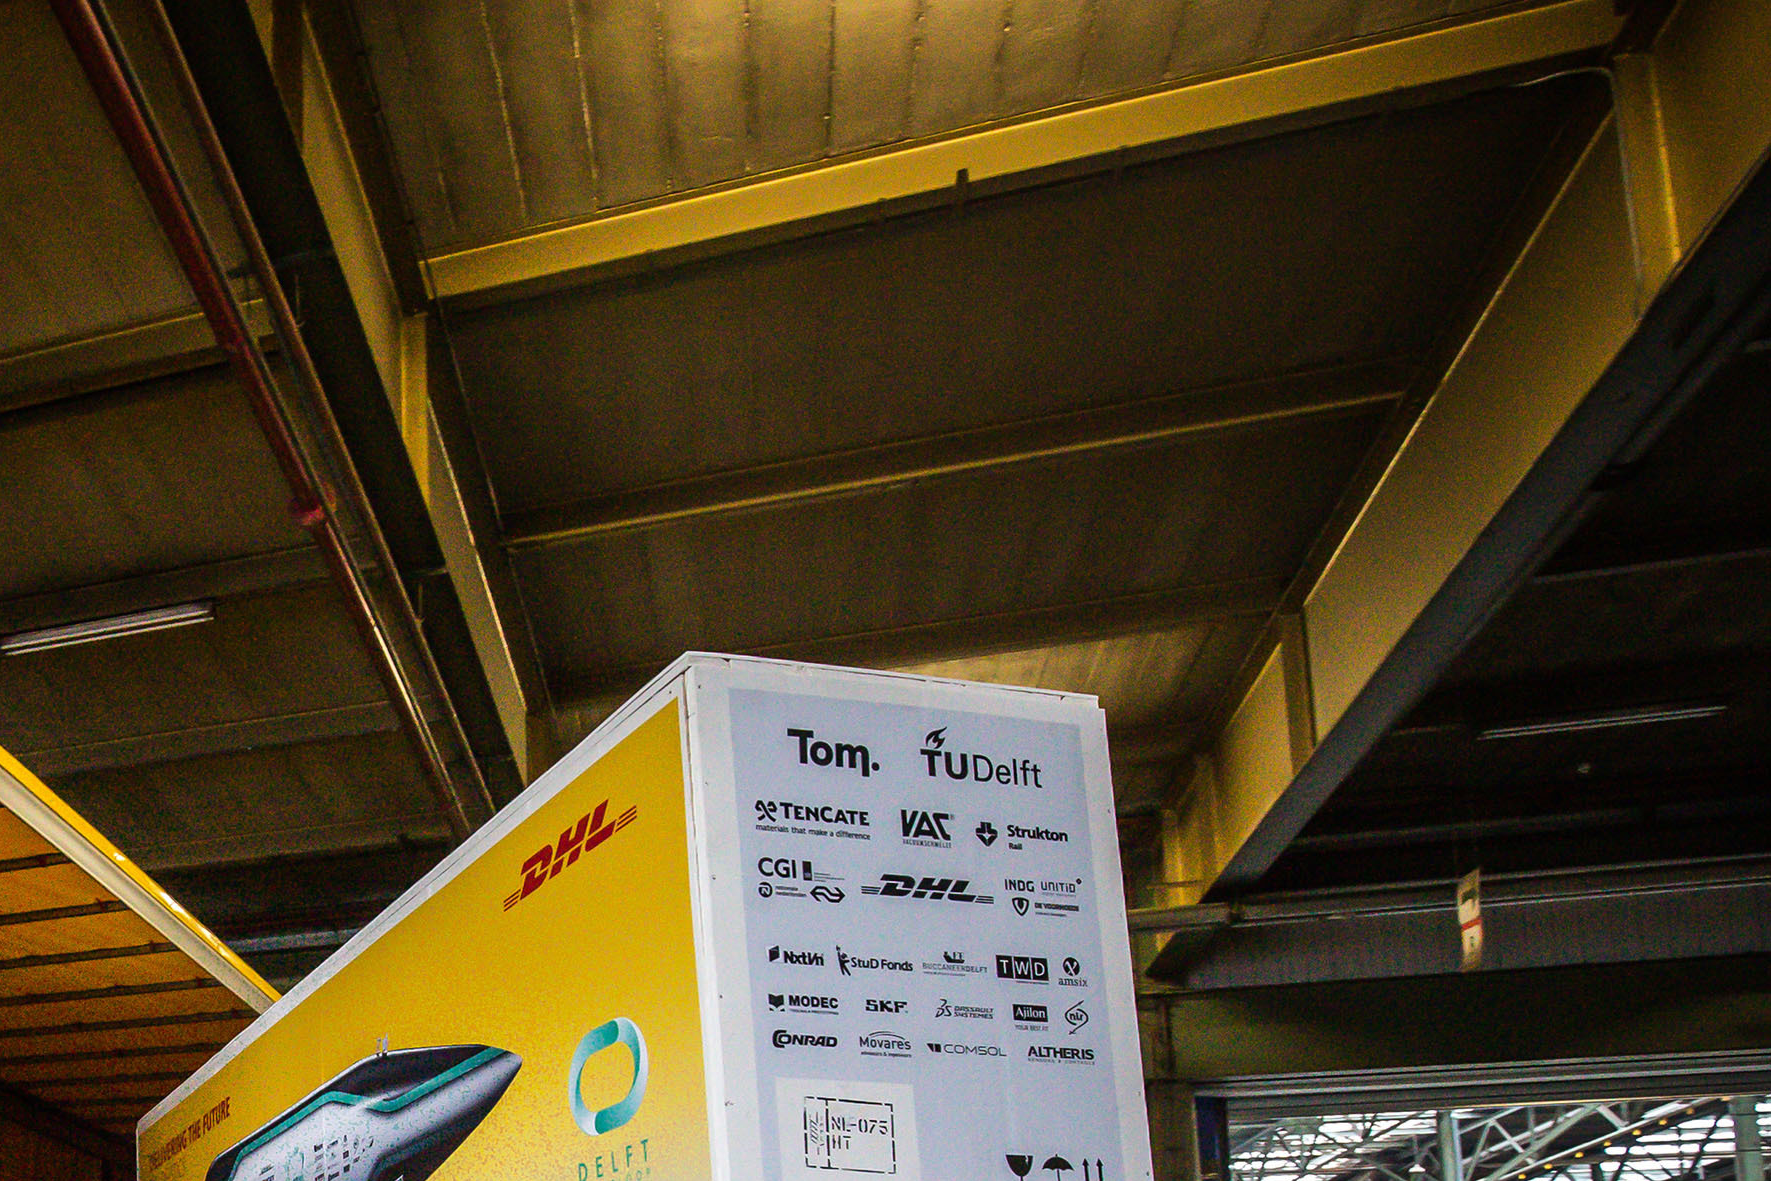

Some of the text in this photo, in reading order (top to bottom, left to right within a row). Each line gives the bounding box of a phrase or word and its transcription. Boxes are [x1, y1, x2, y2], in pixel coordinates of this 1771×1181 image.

[779, 801, 870, 826] TENCATE
[755, 824, 790, 834] materials
[791, 826, 806, 835] that
[808, 828, 828, 837] make
[835, 829, 871, 841] difference
[1007, 824, 1069, 842] Strukton
[518, 798, 618, 901] DHL
[1008, 842, 1023, 850] Rail
[758, 857, 797, 879] CGI
[878, 873, 978, 902] DHL
[1004, 878, 1035, 892] INDG
[880, 958, 913, 971] Fonds
[998, 958, 1047, 978] TWD
[788, 994, 839, 1009] MODEC
[865, 999, 907, 1014] SKF
[1014, 1005, 1047, 1020] Ajilon
[859, 1035, 911, 1050] Movares
[943, 1043, 1007, 1057] COMSOL
[1028, 1045, 1095, 1060] ALTHERIS
[188, 1118, 201, 1144] THE
[202, 1096, 231, 1135] FUTURE
[831, 1116, 888, 1135] NL-075
